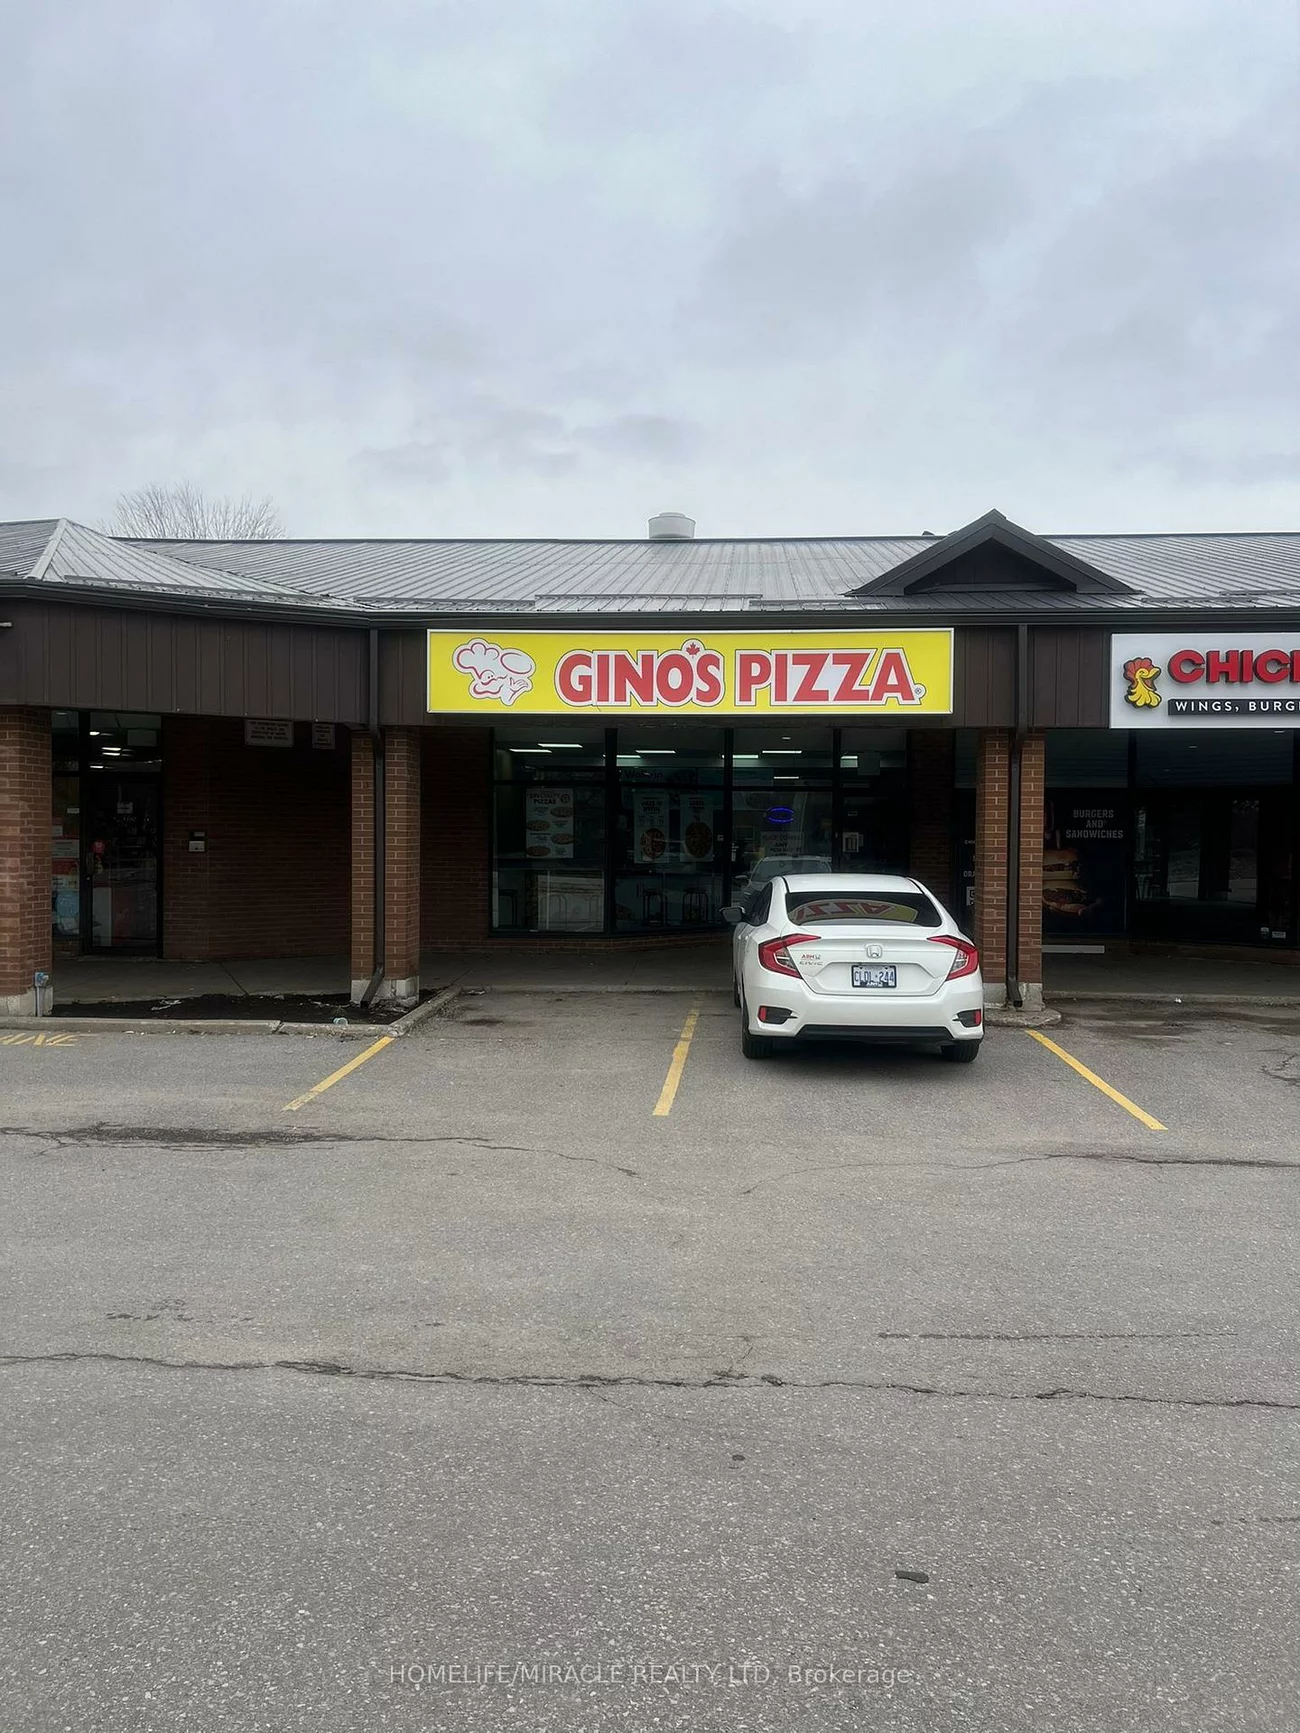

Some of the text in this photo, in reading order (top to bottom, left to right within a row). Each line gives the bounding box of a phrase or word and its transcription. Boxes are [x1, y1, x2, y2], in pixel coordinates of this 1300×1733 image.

[737, 652, 916, 703] PIZZA
[1175, 700, 1300, 713] WINGS, BURG
[1072, 809, 1115, 818] BURGERS
[1085, 819, 1105, 829] AND
[1065, 829, 1124, 839] SANDWICHES
[879, 970, 895, 982] 244
